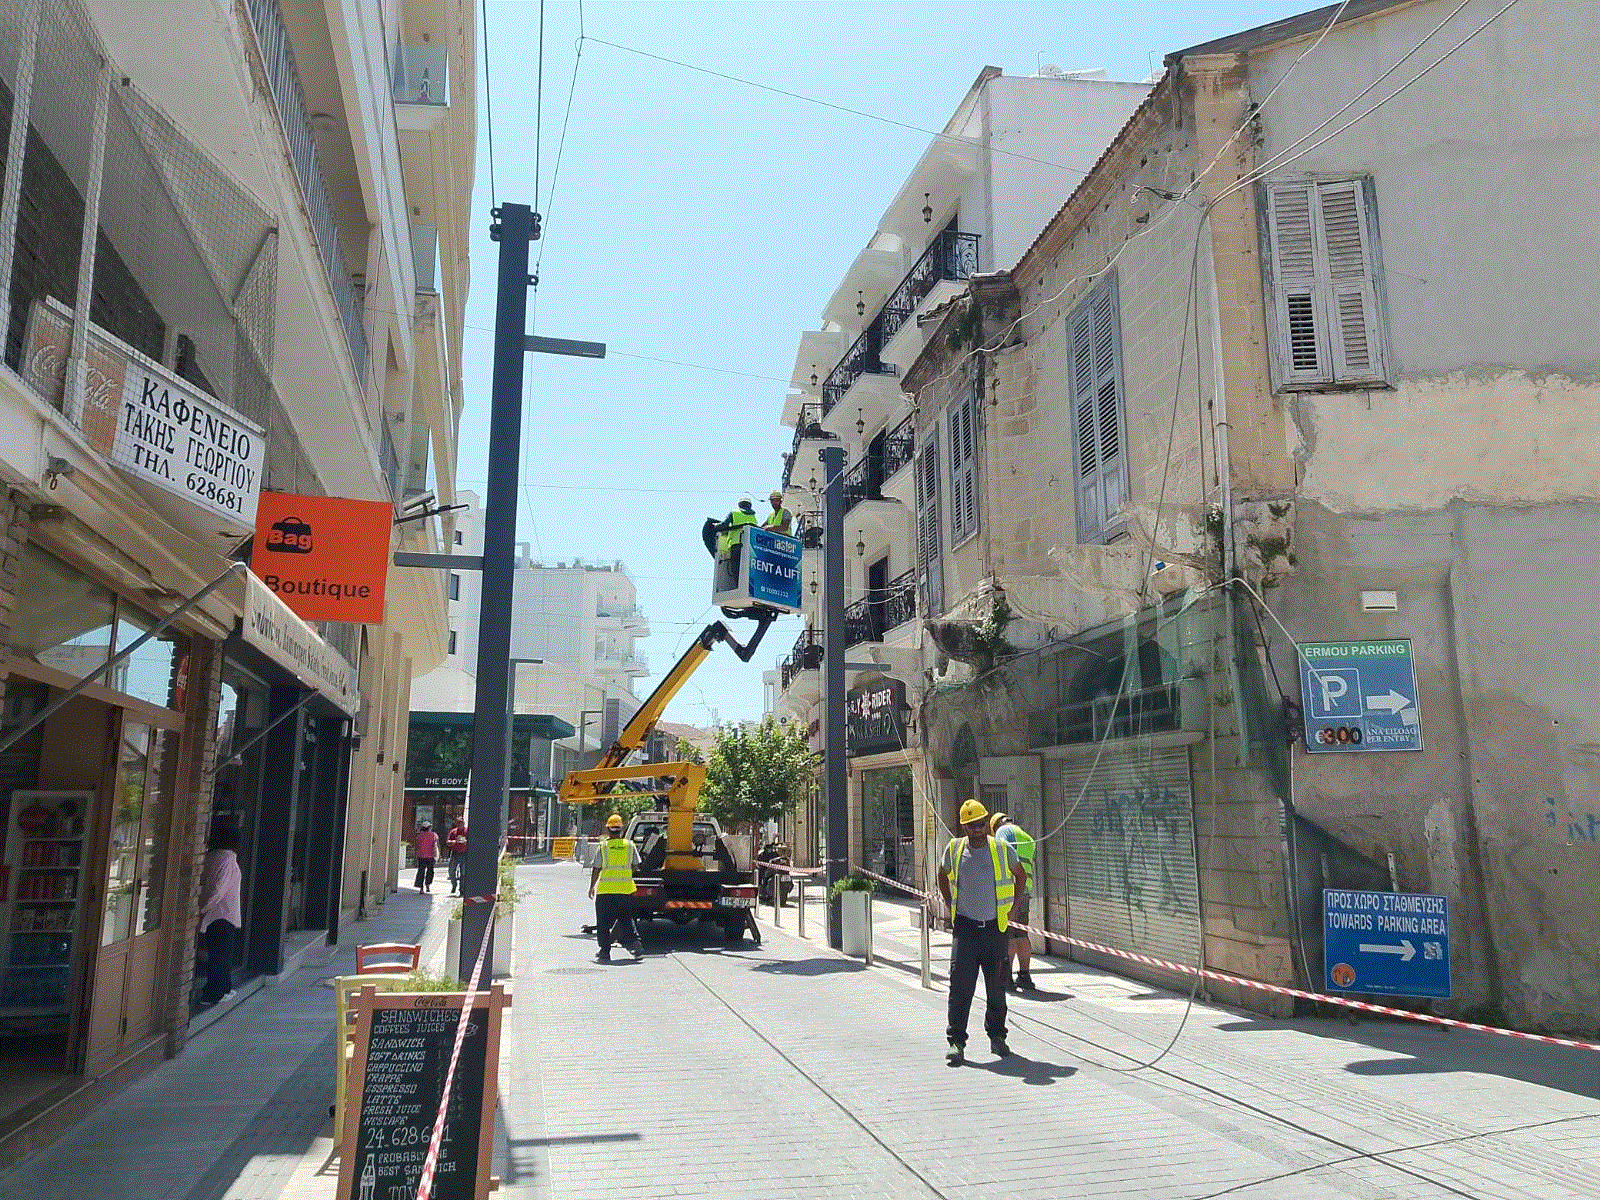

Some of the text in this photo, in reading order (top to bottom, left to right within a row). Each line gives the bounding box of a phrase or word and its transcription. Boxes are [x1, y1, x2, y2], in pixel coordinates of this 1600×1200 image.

[141, 377, 251, 461] ΚΑΦΕΝΕΙΟ
[124, 402, 255, 494] ΤΑΚΗΣ ΓΕΩΡΓΙΟΥ
[133, 443, 243, 513] ΤΗΛ. 628681
[268, 530, 313, 550] Bag
[750, 558, 801, 581] RENT A LIFT
[264, 575, 371, 601] Boutique
[1305, 645, 1405, 657] ERMOU PARKING
[1327, 892, 1445, 914] ΠΡΟΣ ΧΩΡΟ ΣΤΑΘΜΕΥΣΗΣ
[1328, 913, 1446, 934] TOWARDS PARKING AREA
[381, 1010, 458, 1023] SANDWICHES
[374, 1023, 445, 1034] COFFEES JUICES
[371, 1038, 425, 1050] SANDWICH
[369, 1051, 425, 1061] SOFT DRINKS
[366, 1063, 424, 1073] CAPPUCCINO
[367, 1073, 403, 1083] FRAPPE
[366, 1095, 402, 1105] LATTE
[363, 1104, 422, 1115] FRESH JUICE
[391, 1123, 453, 1147] 62861
[378, 1151, 425, 1164] PROBABLY
[378, 1165, 400, 1177] BEST
[406, 1176, 415, 1186] IN
